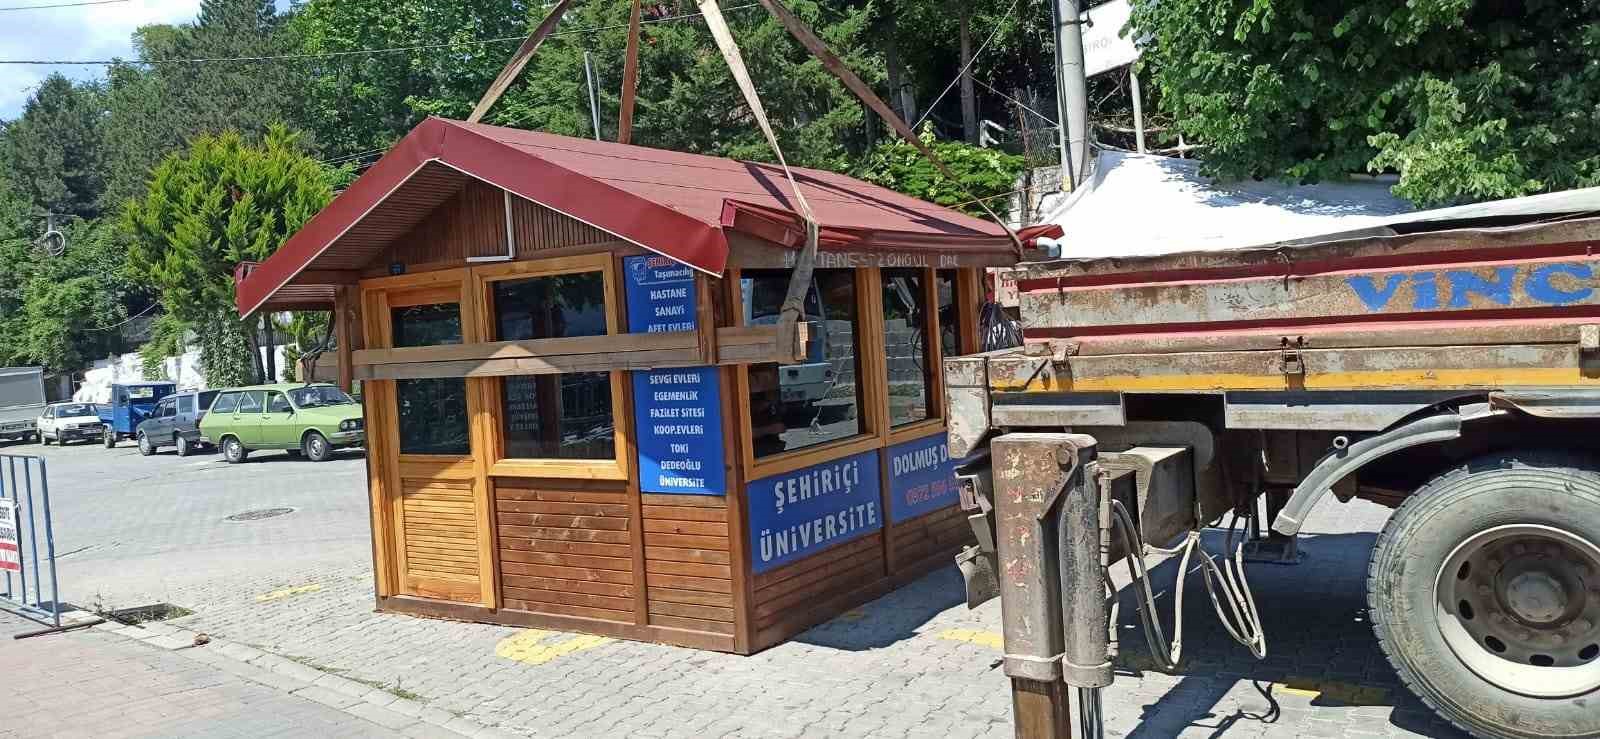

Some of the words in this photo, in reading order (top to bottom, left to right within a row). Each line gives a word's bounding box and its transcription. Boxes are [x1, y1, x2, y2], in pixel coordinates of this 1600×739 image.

[650, 288, 687, 300] HASTANE
[655, 304, 685, 317] SANAYİ
[648, 322, 667, 333] AFET
[668, 320, 695, 333] EVLERİ
[650, 373, 672, 384] SEVGİ
[673, 372, 701, 384] EVLERİ
[654, 390, 698, 401] EGEMENLİK
[650, 407, 680, 418] FAZİLET
[681, 407, 705, 418] SİTESİ
[654, 424, 704, 435] KOOP.EVLERİ
[670, 443, 689, 454] TOKİ
[660, 458, 702, 471] DEDEOĞLU
[893, 445, 939, 476] DOLMUŞ
[659, 475, 705, 488] ÜNİVERSİTE
[774, 460, 859, 514] ŞEHİRİÇİ
[759, 501, 877, 562] ÜNİVERSİTE
